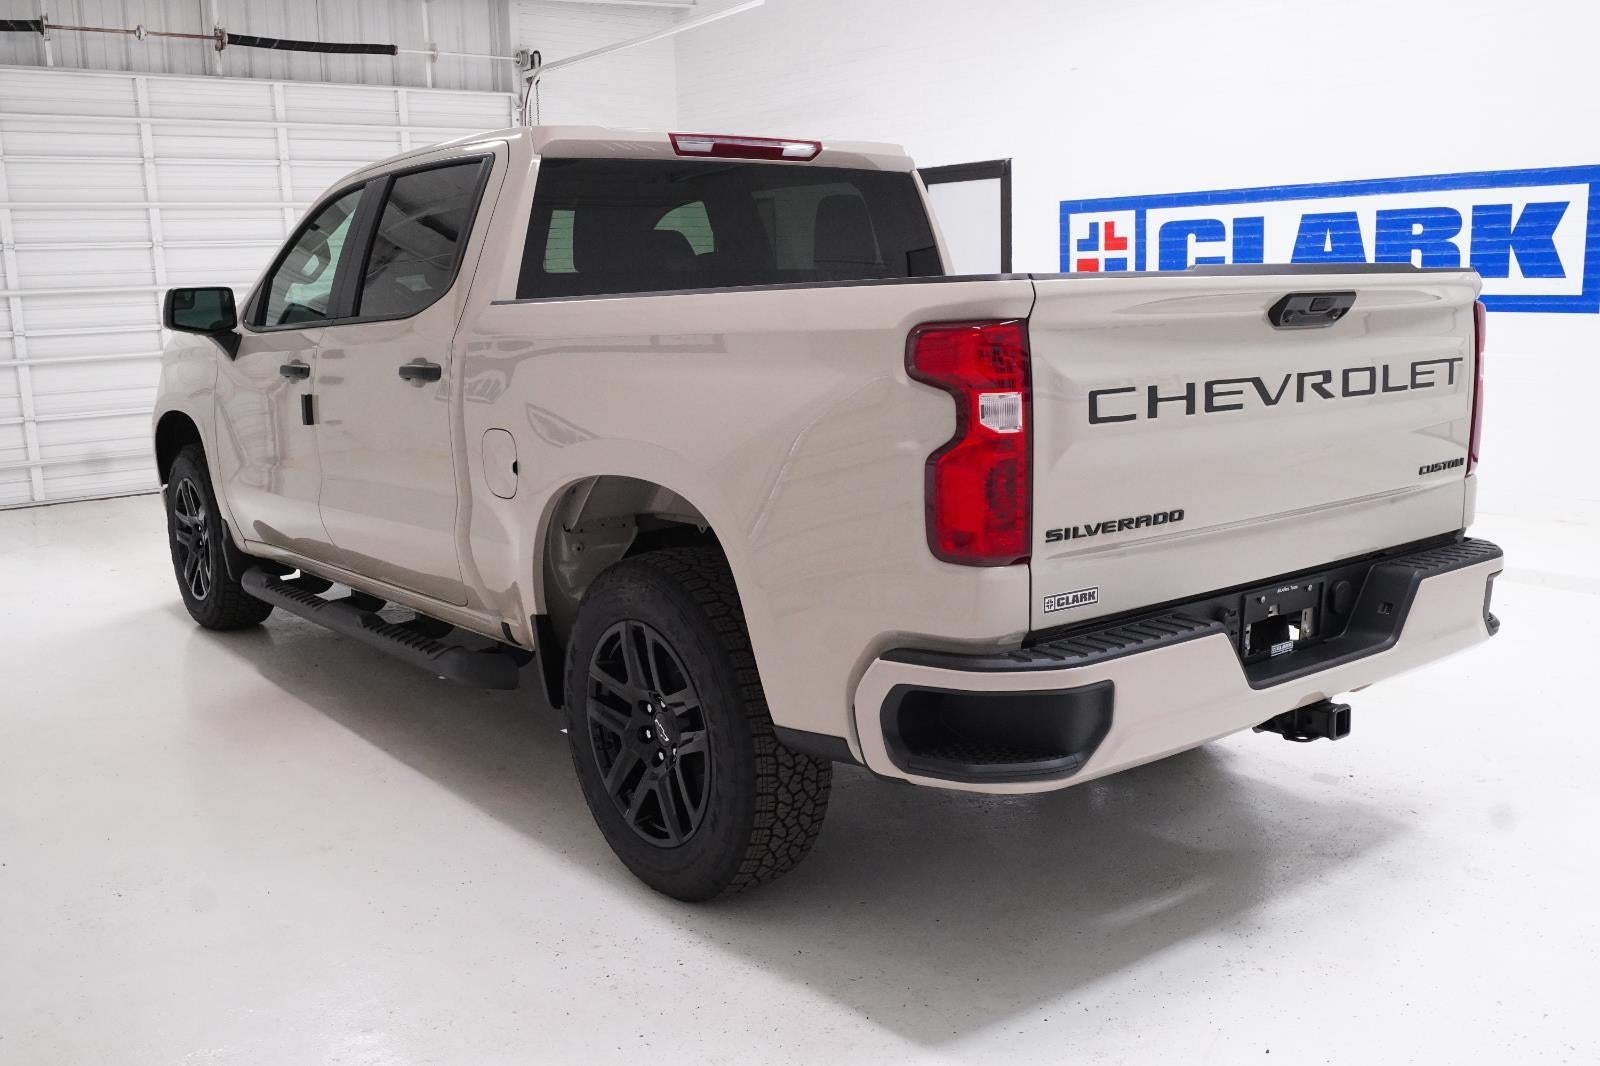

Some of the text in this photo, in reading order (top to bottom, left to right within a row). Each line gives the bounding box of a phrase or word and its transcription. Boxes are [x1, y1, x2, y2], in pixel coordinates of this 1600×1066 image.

[1158, 201, 1571, 278] CLARK
[1088, 357, 1464, 424] CHEVROLET
[1418, 457, 1465, 476] CUSTOM
[1045, 509, 1185, 543] SILVERADO
[1056, 590, 1096, 608] CLARK
